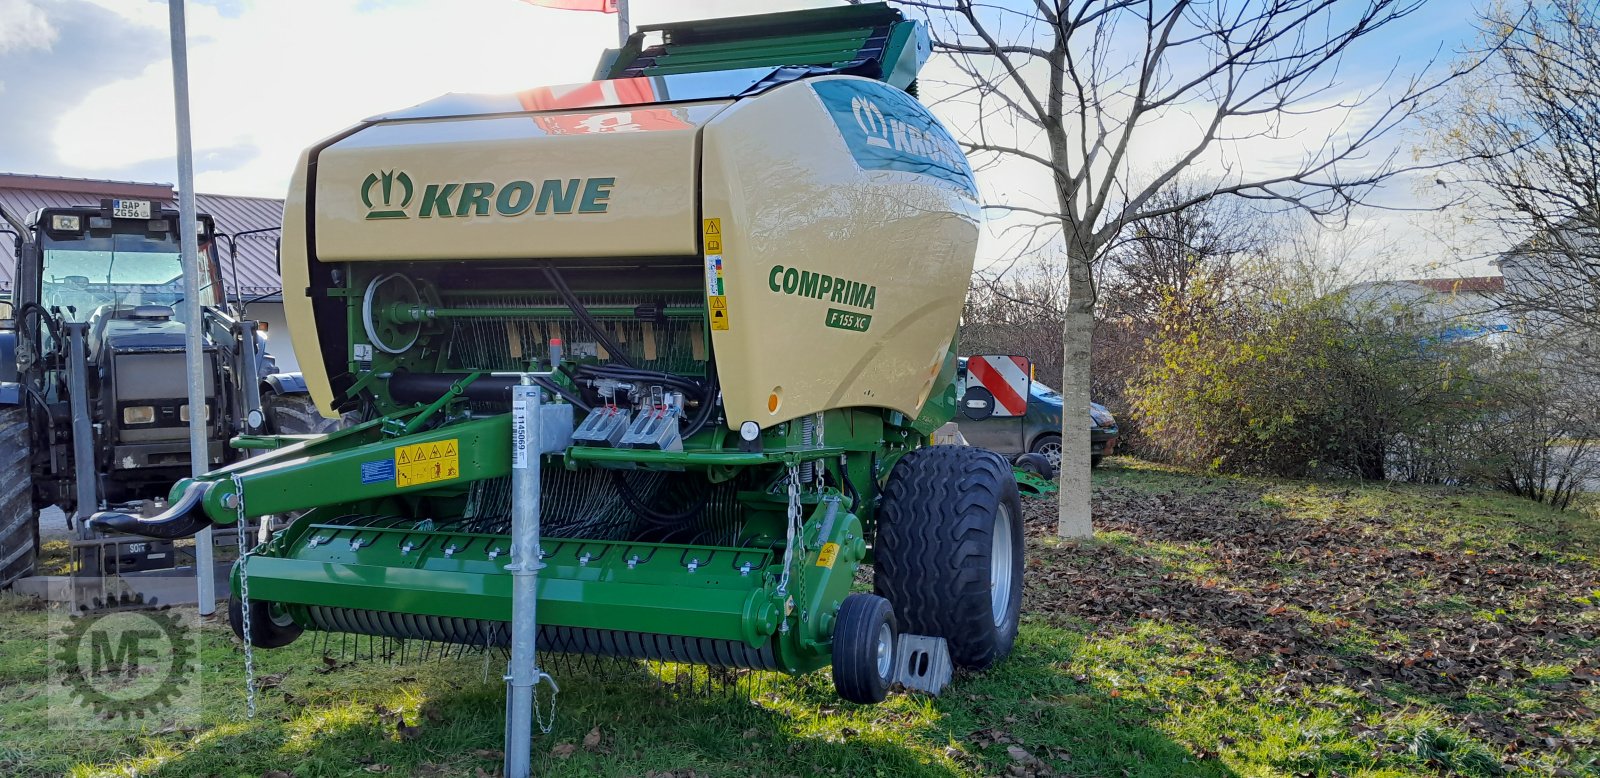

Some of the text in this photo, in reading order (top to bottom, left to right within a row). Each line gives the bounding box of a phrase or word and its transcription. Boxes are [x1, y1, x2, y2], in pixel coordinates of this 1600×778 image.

[121, 201, 140, 210] GAP
[418, 177, 615, 218] KRONE
[114, 209, 140, 217] ZG56
[768, 264, 877, 310] COMPRIMA
[831, 312, 867, 329] F 155 XC
[518, 415, 526, 450] 1145069
